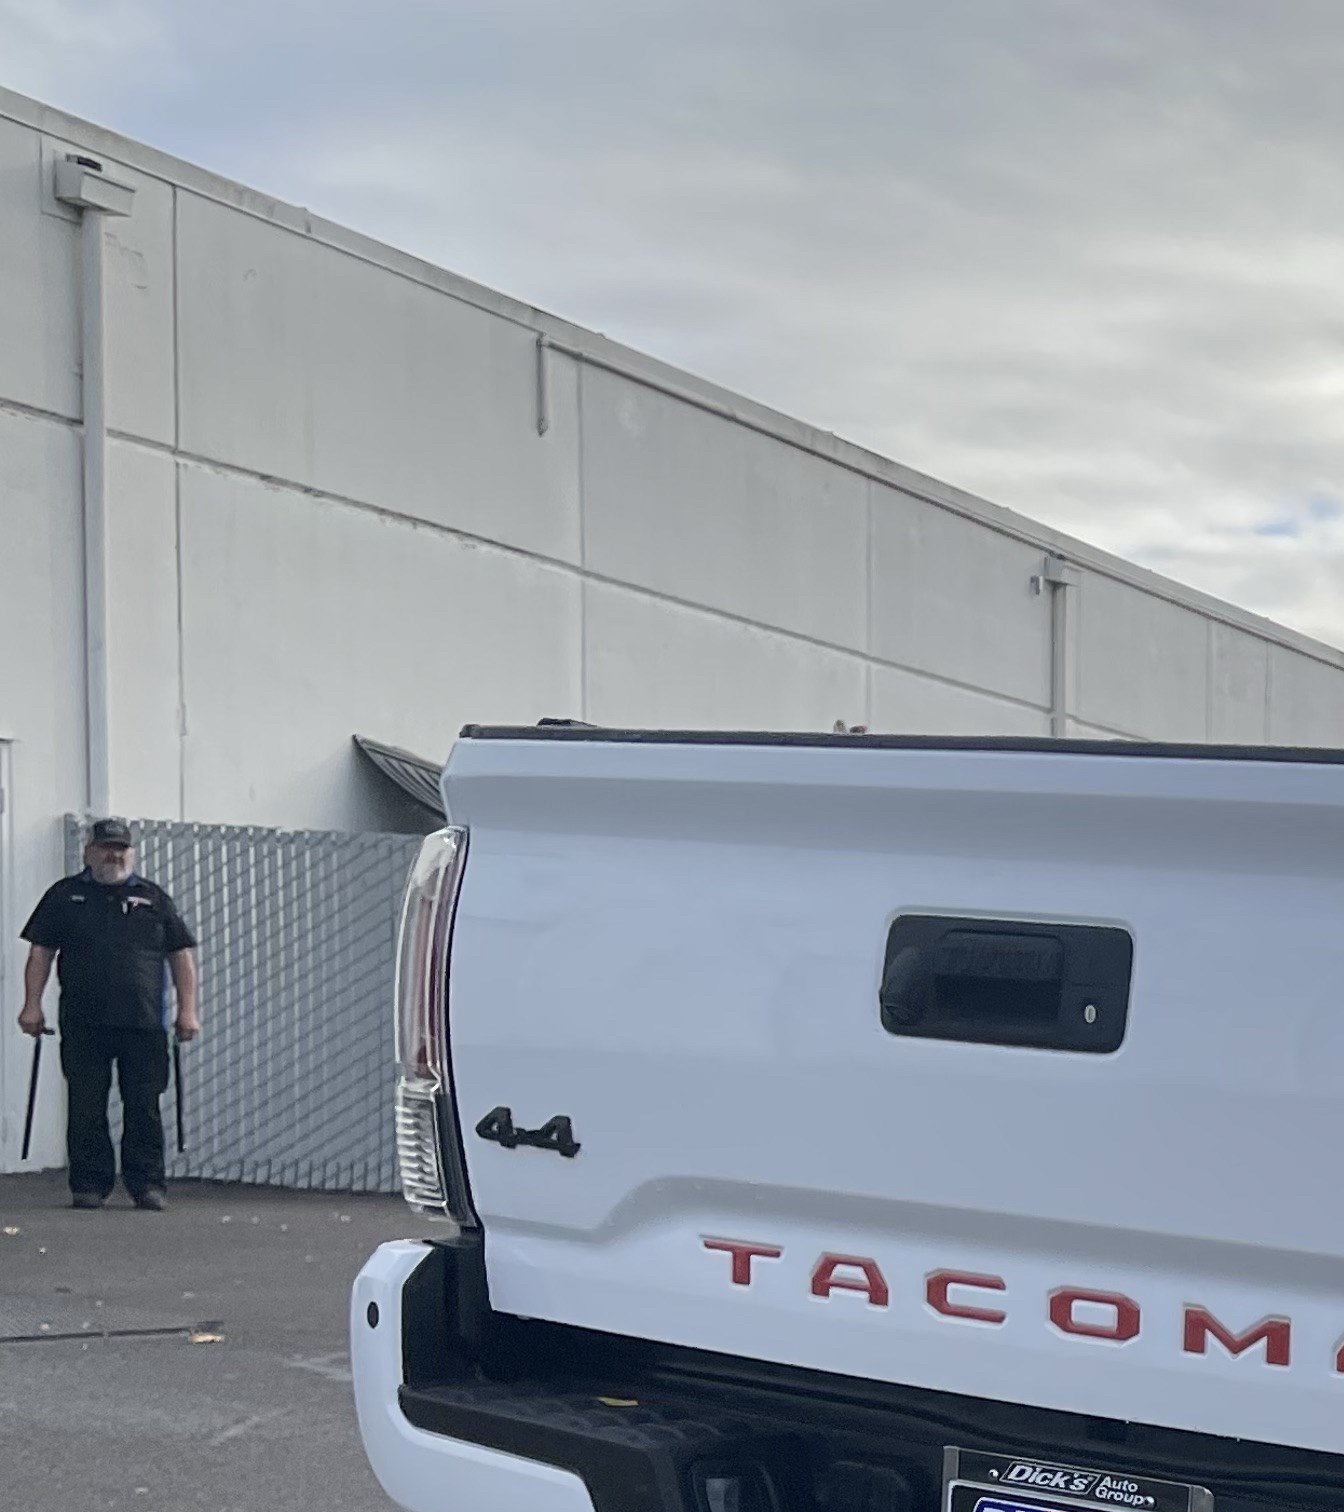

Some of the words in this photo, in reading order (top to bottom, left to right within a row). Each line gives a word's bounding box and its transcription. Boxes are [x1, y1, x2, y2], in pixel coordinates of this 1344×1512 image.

[1007, 1464, 1090, 1491] Dick's
[1101, 1476, 1139, 1492] Auto
[1095, 1487, 1145, 1506] Group
